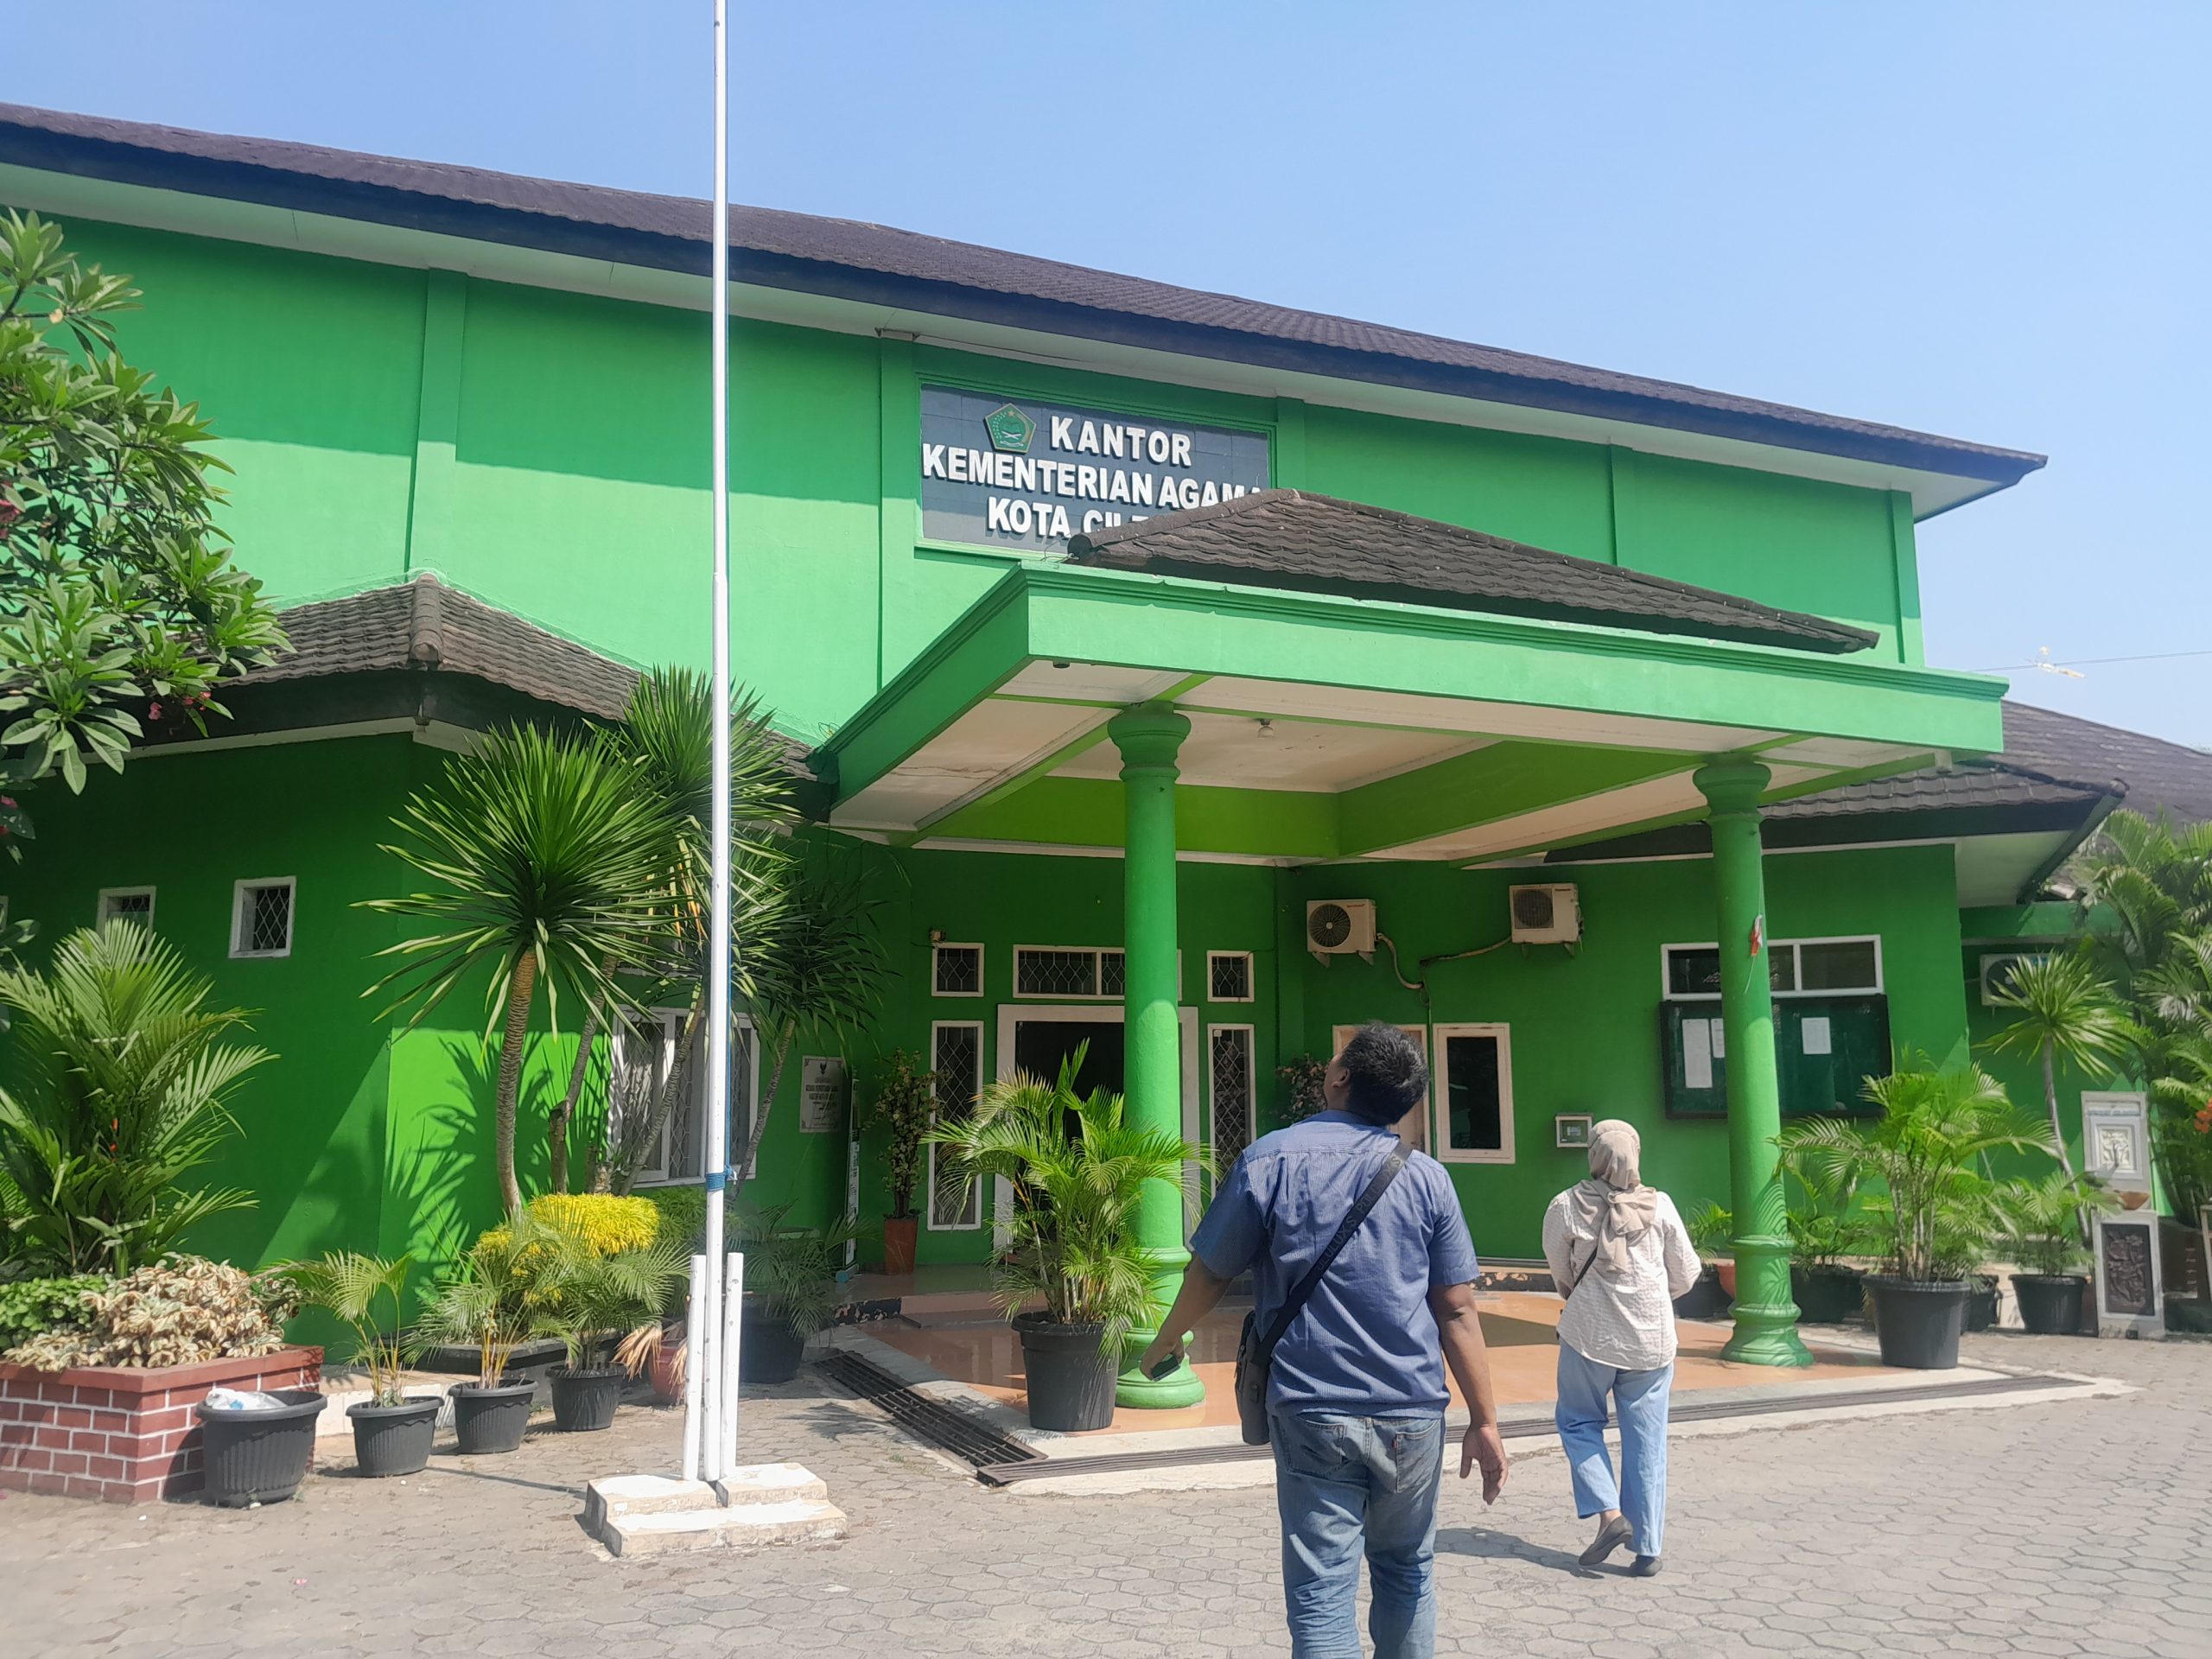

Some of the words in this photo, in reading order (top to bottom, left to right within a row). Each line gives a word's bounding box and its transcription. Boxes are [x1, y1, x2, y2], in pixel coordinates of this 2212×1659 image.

[1051, 416, 1192, 467] KANTOR
[922, 442, 1154, 505] KEMENTERIAN
[1158, 475, 1262, 510] AGAM
[988, 496, 1071, 538] KOTA
